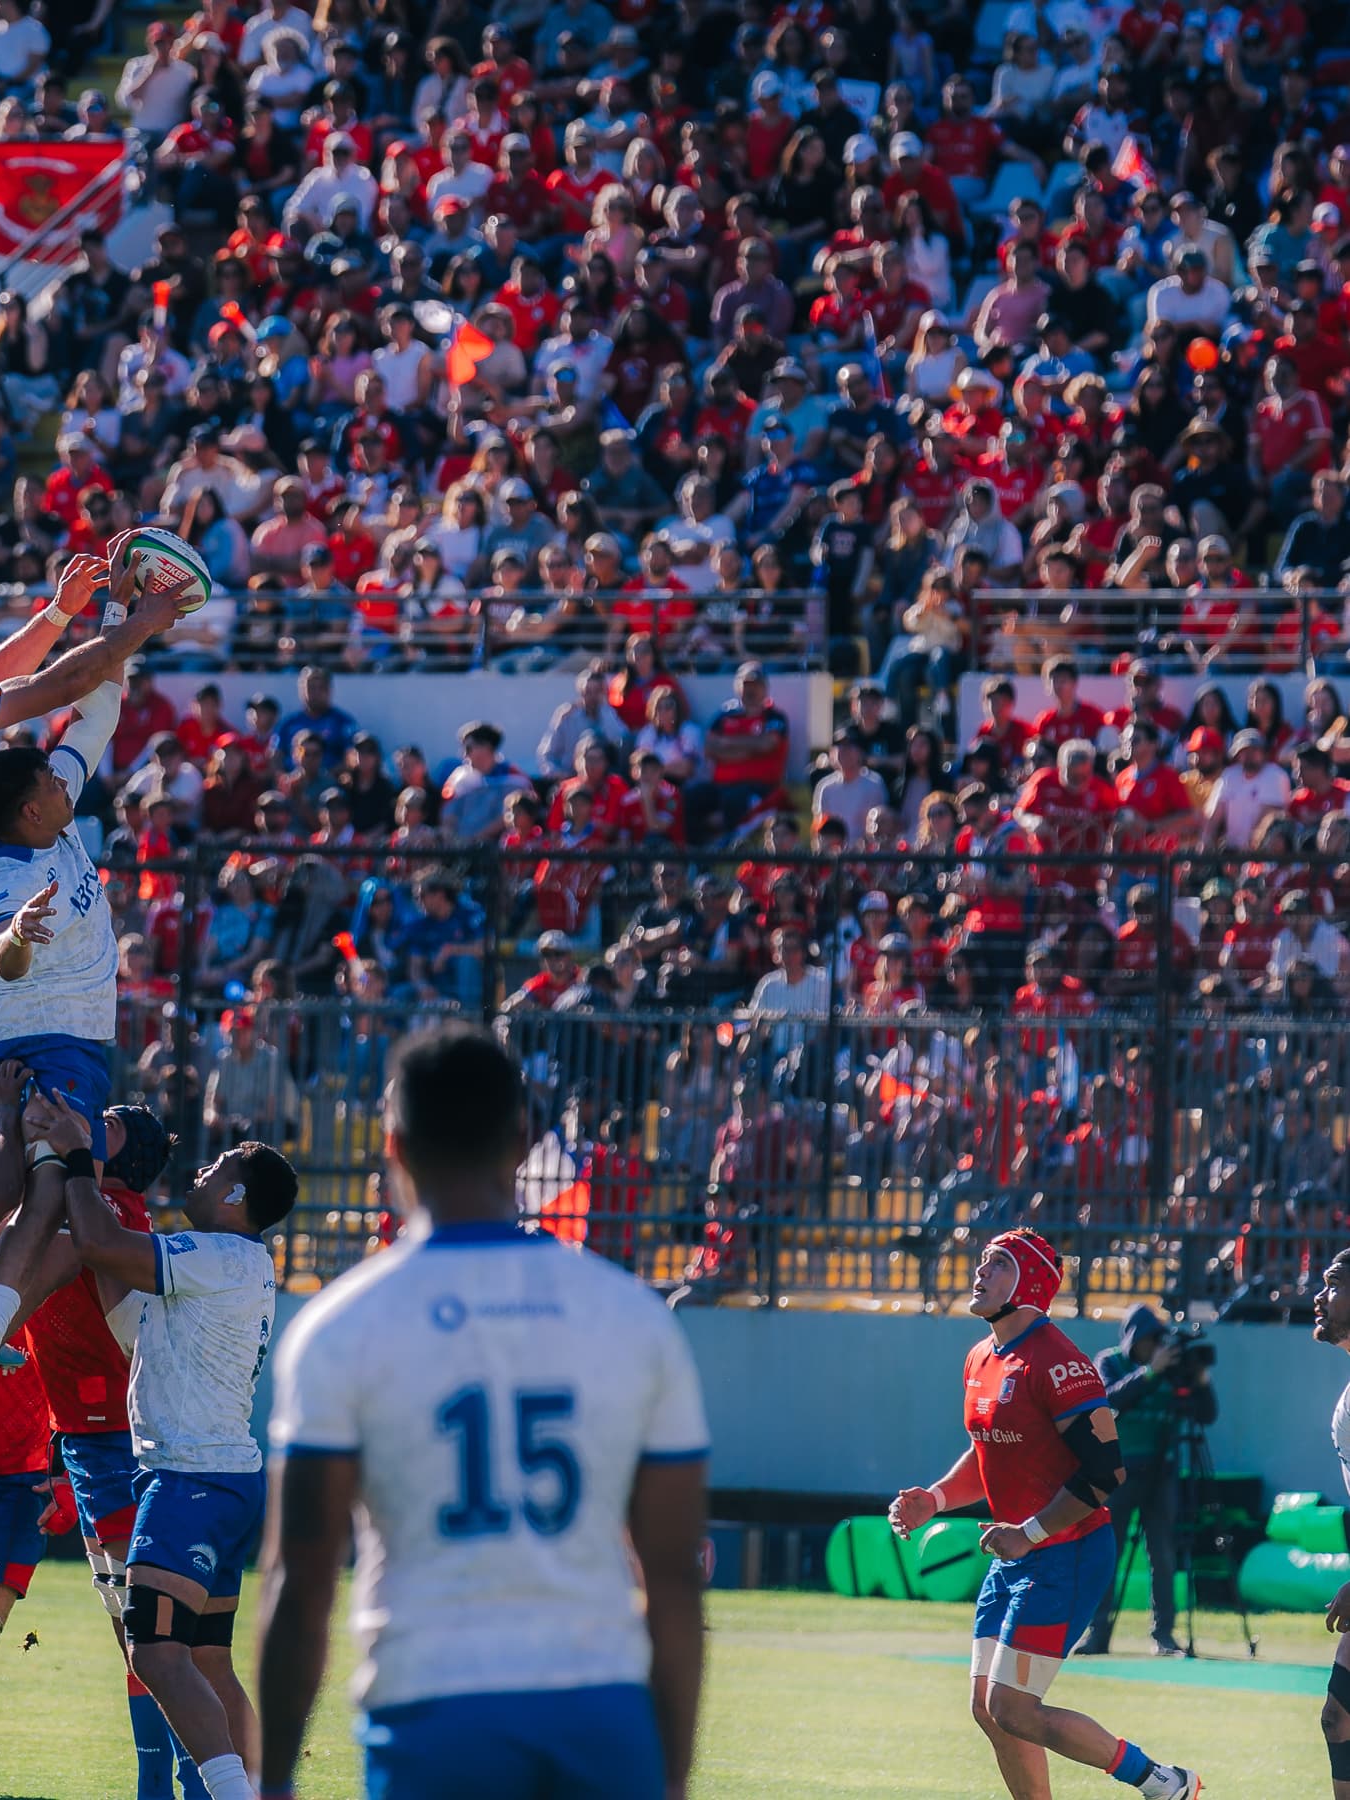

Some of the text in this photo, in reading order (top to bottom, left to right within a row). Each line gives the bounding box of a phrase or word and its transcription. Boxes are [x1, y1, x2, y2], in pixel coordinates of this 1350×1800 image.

[157, 572, 176, 587] RUG
[992, 1428, 1024, 1444] Chile
[436, 1382, 581, 1537] 15
